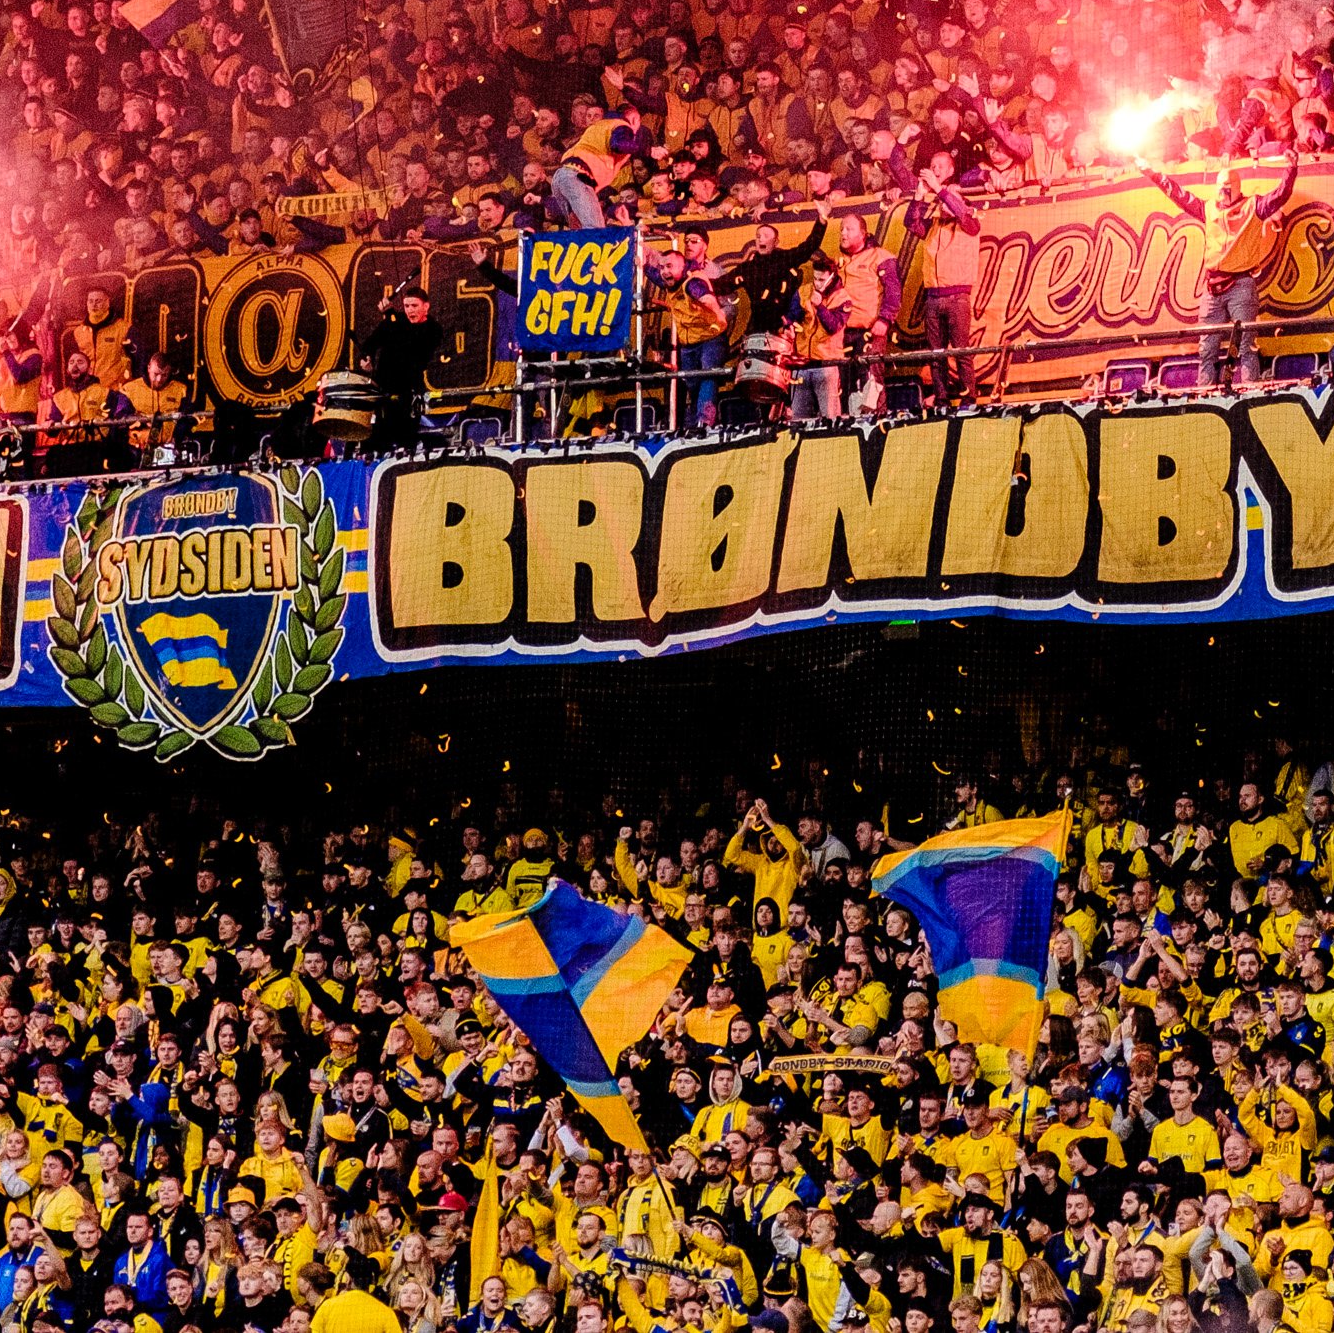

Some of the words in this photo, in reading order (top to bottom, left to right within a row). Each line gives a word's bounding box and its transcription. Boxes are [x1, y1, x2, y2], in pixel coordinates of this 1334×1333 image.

[255, 255, 304, 273] ALPHA
[529, 236, 630, 285] FUCK
[525, 288, 622, 336] GFH!
[163, 487, 238, 520] BRØNDBY
[96, 526, 300, 604] SYDSIDEN
